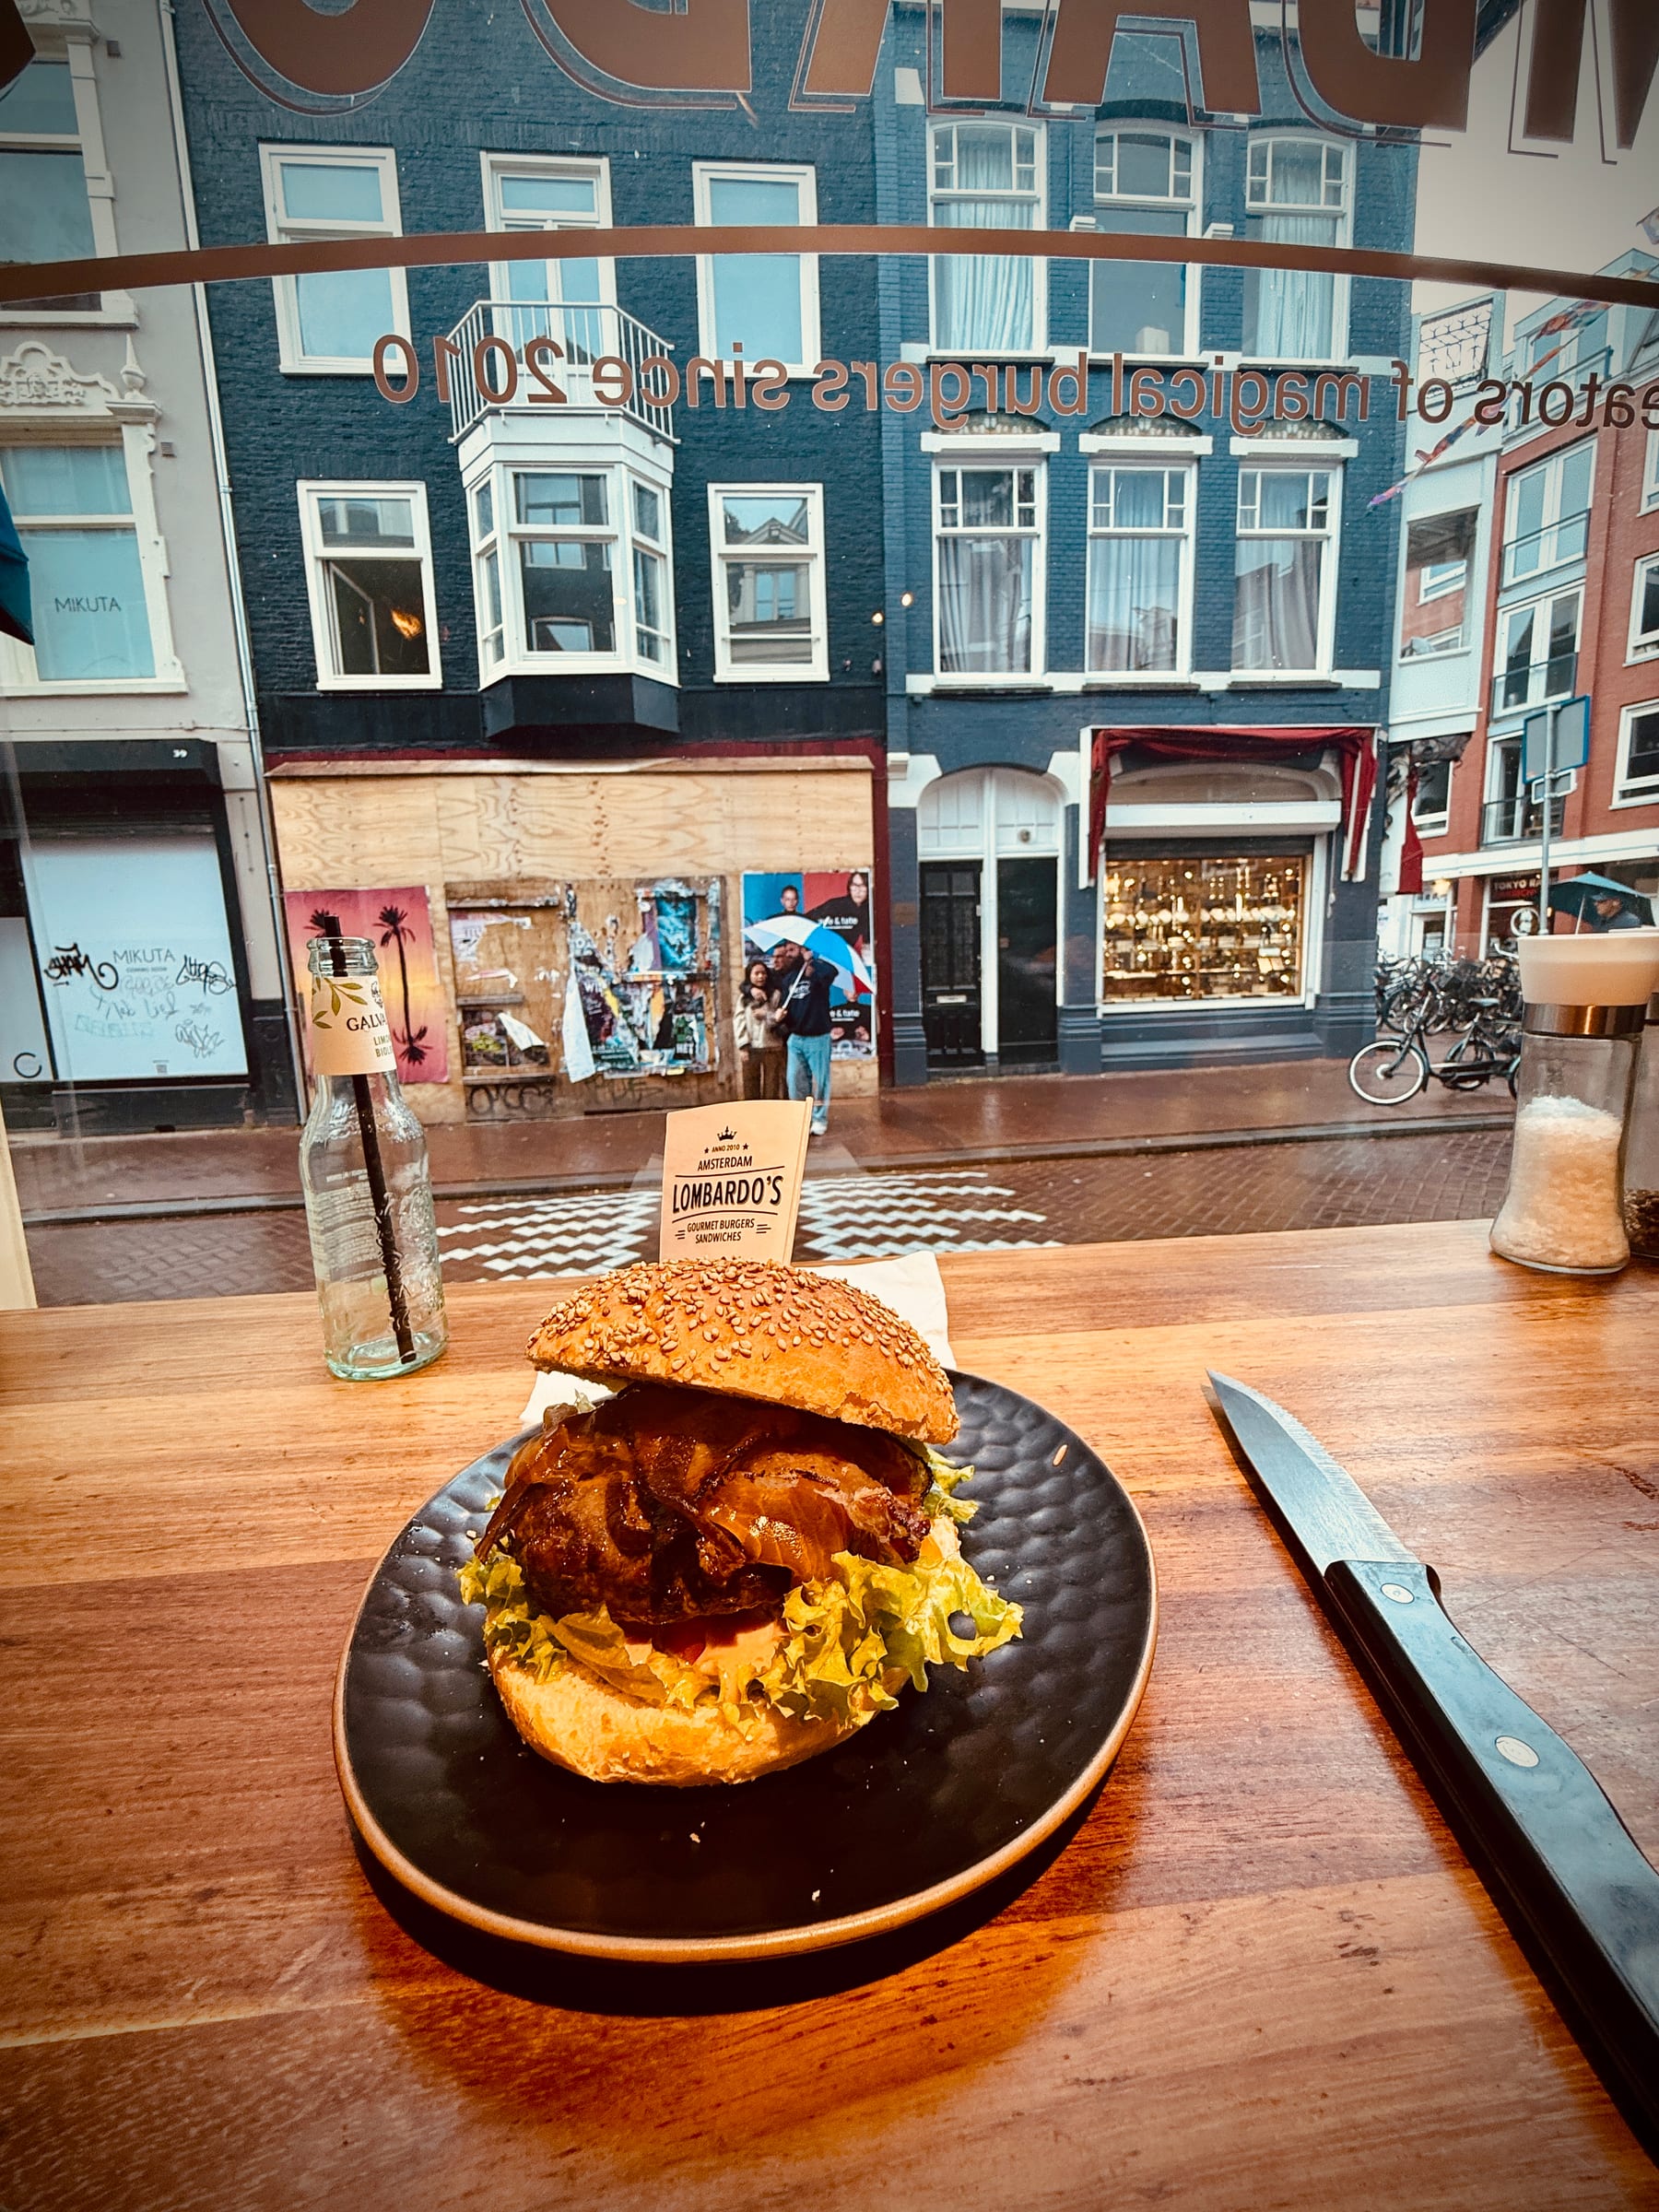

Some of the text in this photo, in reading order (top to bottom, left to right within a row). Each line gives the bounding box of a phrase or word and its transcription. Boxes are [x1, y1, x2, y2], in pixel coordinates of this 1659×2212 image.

[54, 595, 122, 613] MIKUTA
[1493, 878, 1527, 891] TOKYO
[112, 947, 175, 964] MIKUTA
[712, 1145, 725, 1153] ANNO
[698, 1155, 753, 1171] AMSTERDAM
[673, 1175, 784, 1214] LOMBARDO'S
[687, 1218, 756, 1232] GOURMET BURGERS
[695, 1230, 742, 1244] SANDWICHES
